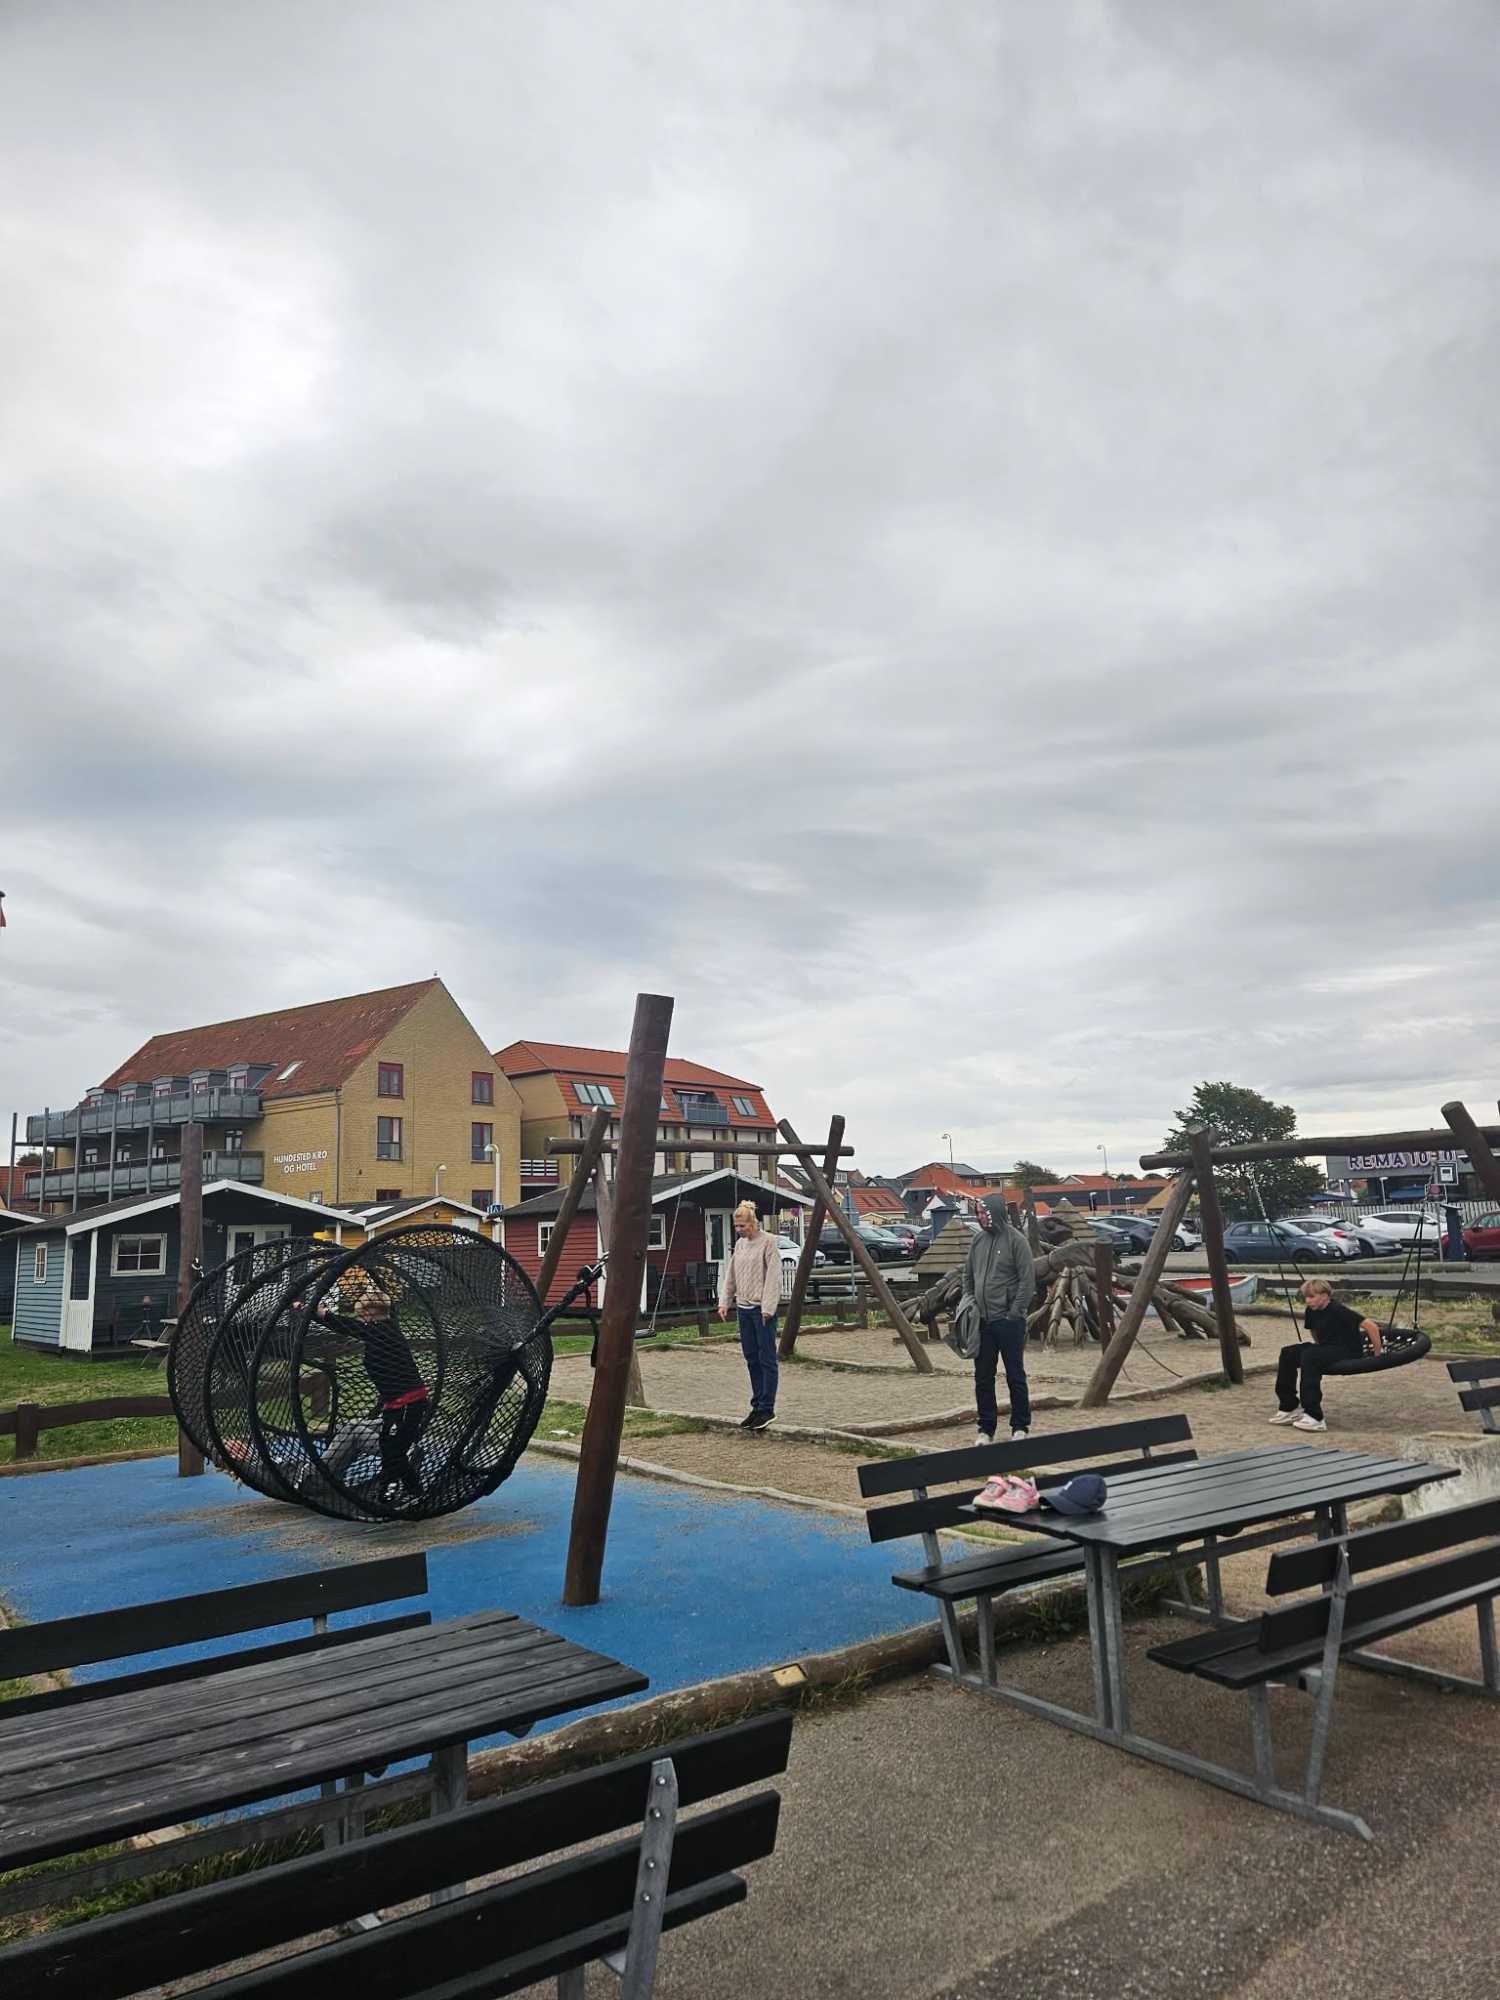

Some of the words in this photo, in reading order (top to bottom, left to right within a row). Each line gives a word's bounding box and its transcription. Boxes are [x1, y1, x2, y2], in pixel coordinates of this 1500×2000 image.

[273, 1152, 311, 1163] HUNDESTED
[312, 1150, 328, 1160] KRO
[1349, 1152, 1406, 1170] REMA
[284, 1164, 295, 1174] OG
[296, 1162, 317, 1172] HOTEL
[217, 1224, 223, 1233] 2
